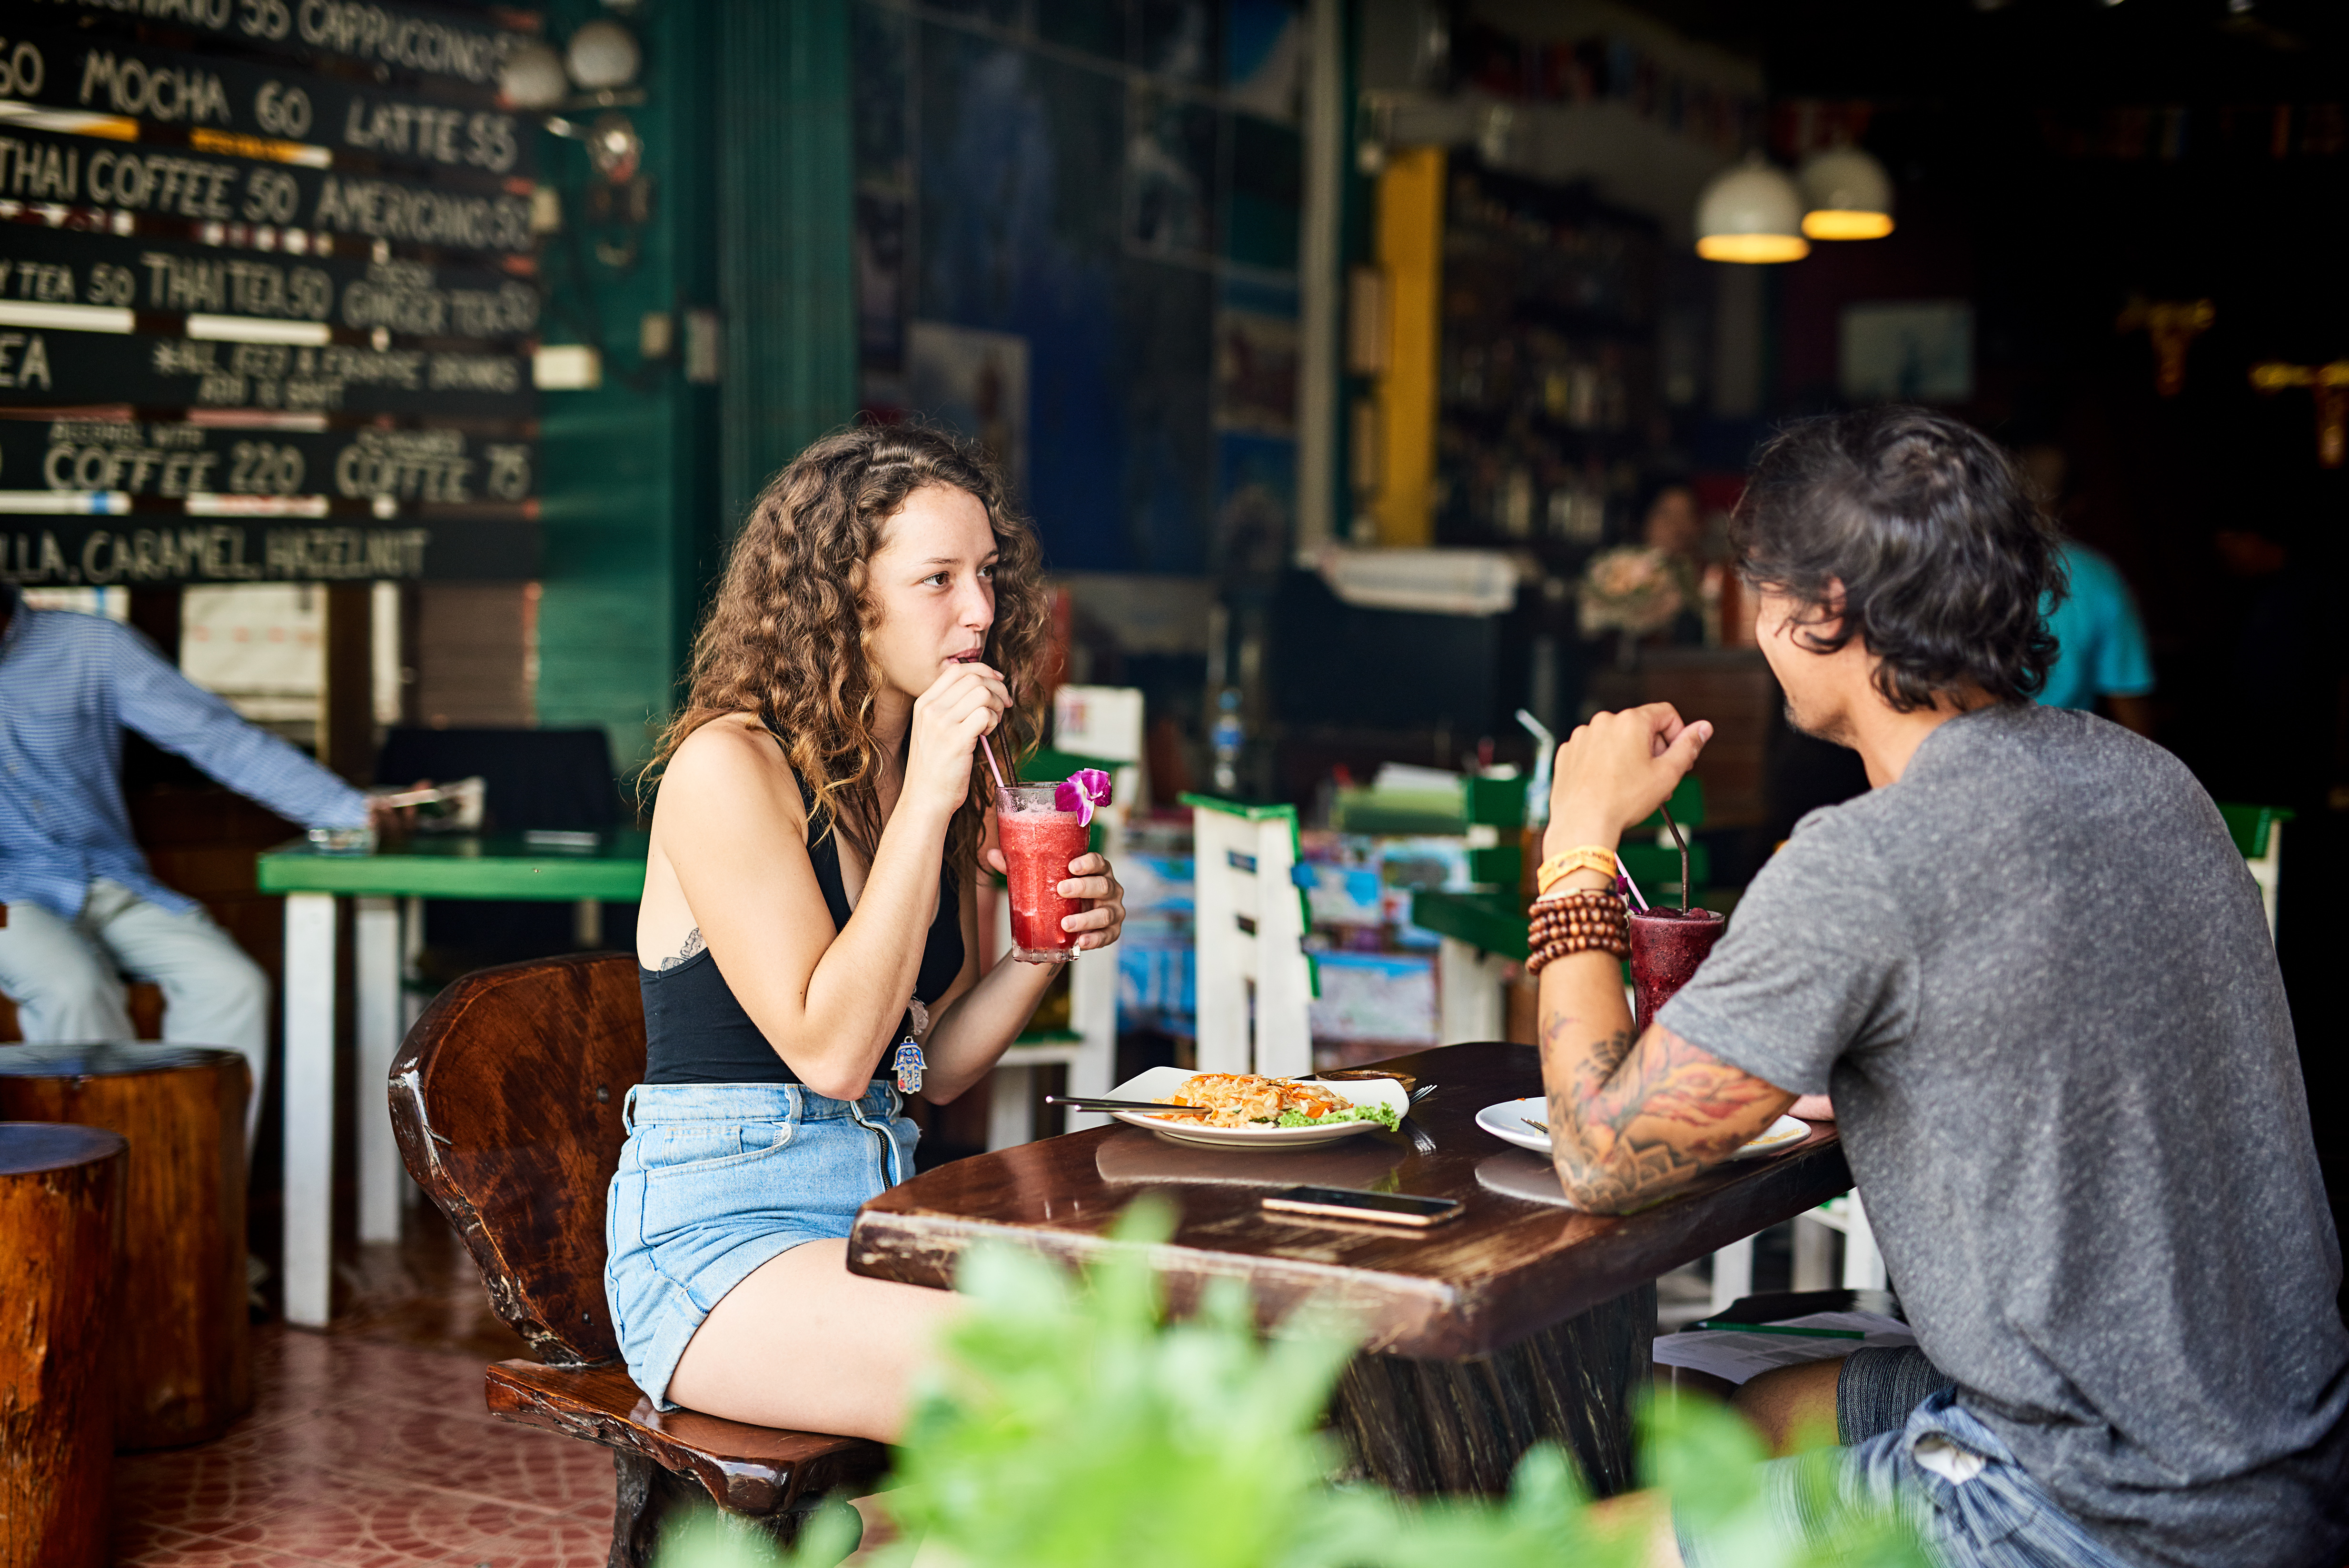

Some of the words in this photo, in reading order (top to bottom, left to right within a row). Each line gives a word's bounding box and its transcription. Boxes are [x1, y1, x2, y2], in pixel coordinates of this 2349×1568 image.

[79, 48, 232, 125] MOCHA
[255, 79, 313, 139] 60
[343, 94, 465, 164] LATTE
[466, 112, 518, 173] 55
[0, 137, 79, 201] THAI
[88, 148, 239, 220] COFFEE
[241, 166, 301, 224] 50
[312, 172, 492, 250] AMERICANO
[16, 259, 77, 304] TEA
[86, 261, 137, 308] 50
[140, 250, 226, 312] THAI
[45, 443, 222, 499] COFFEE
[229, 438, 306, 496] 220
[335, 444, 476, 501] COFFEE
[263, 526, 430, 581] HAZELNUT
